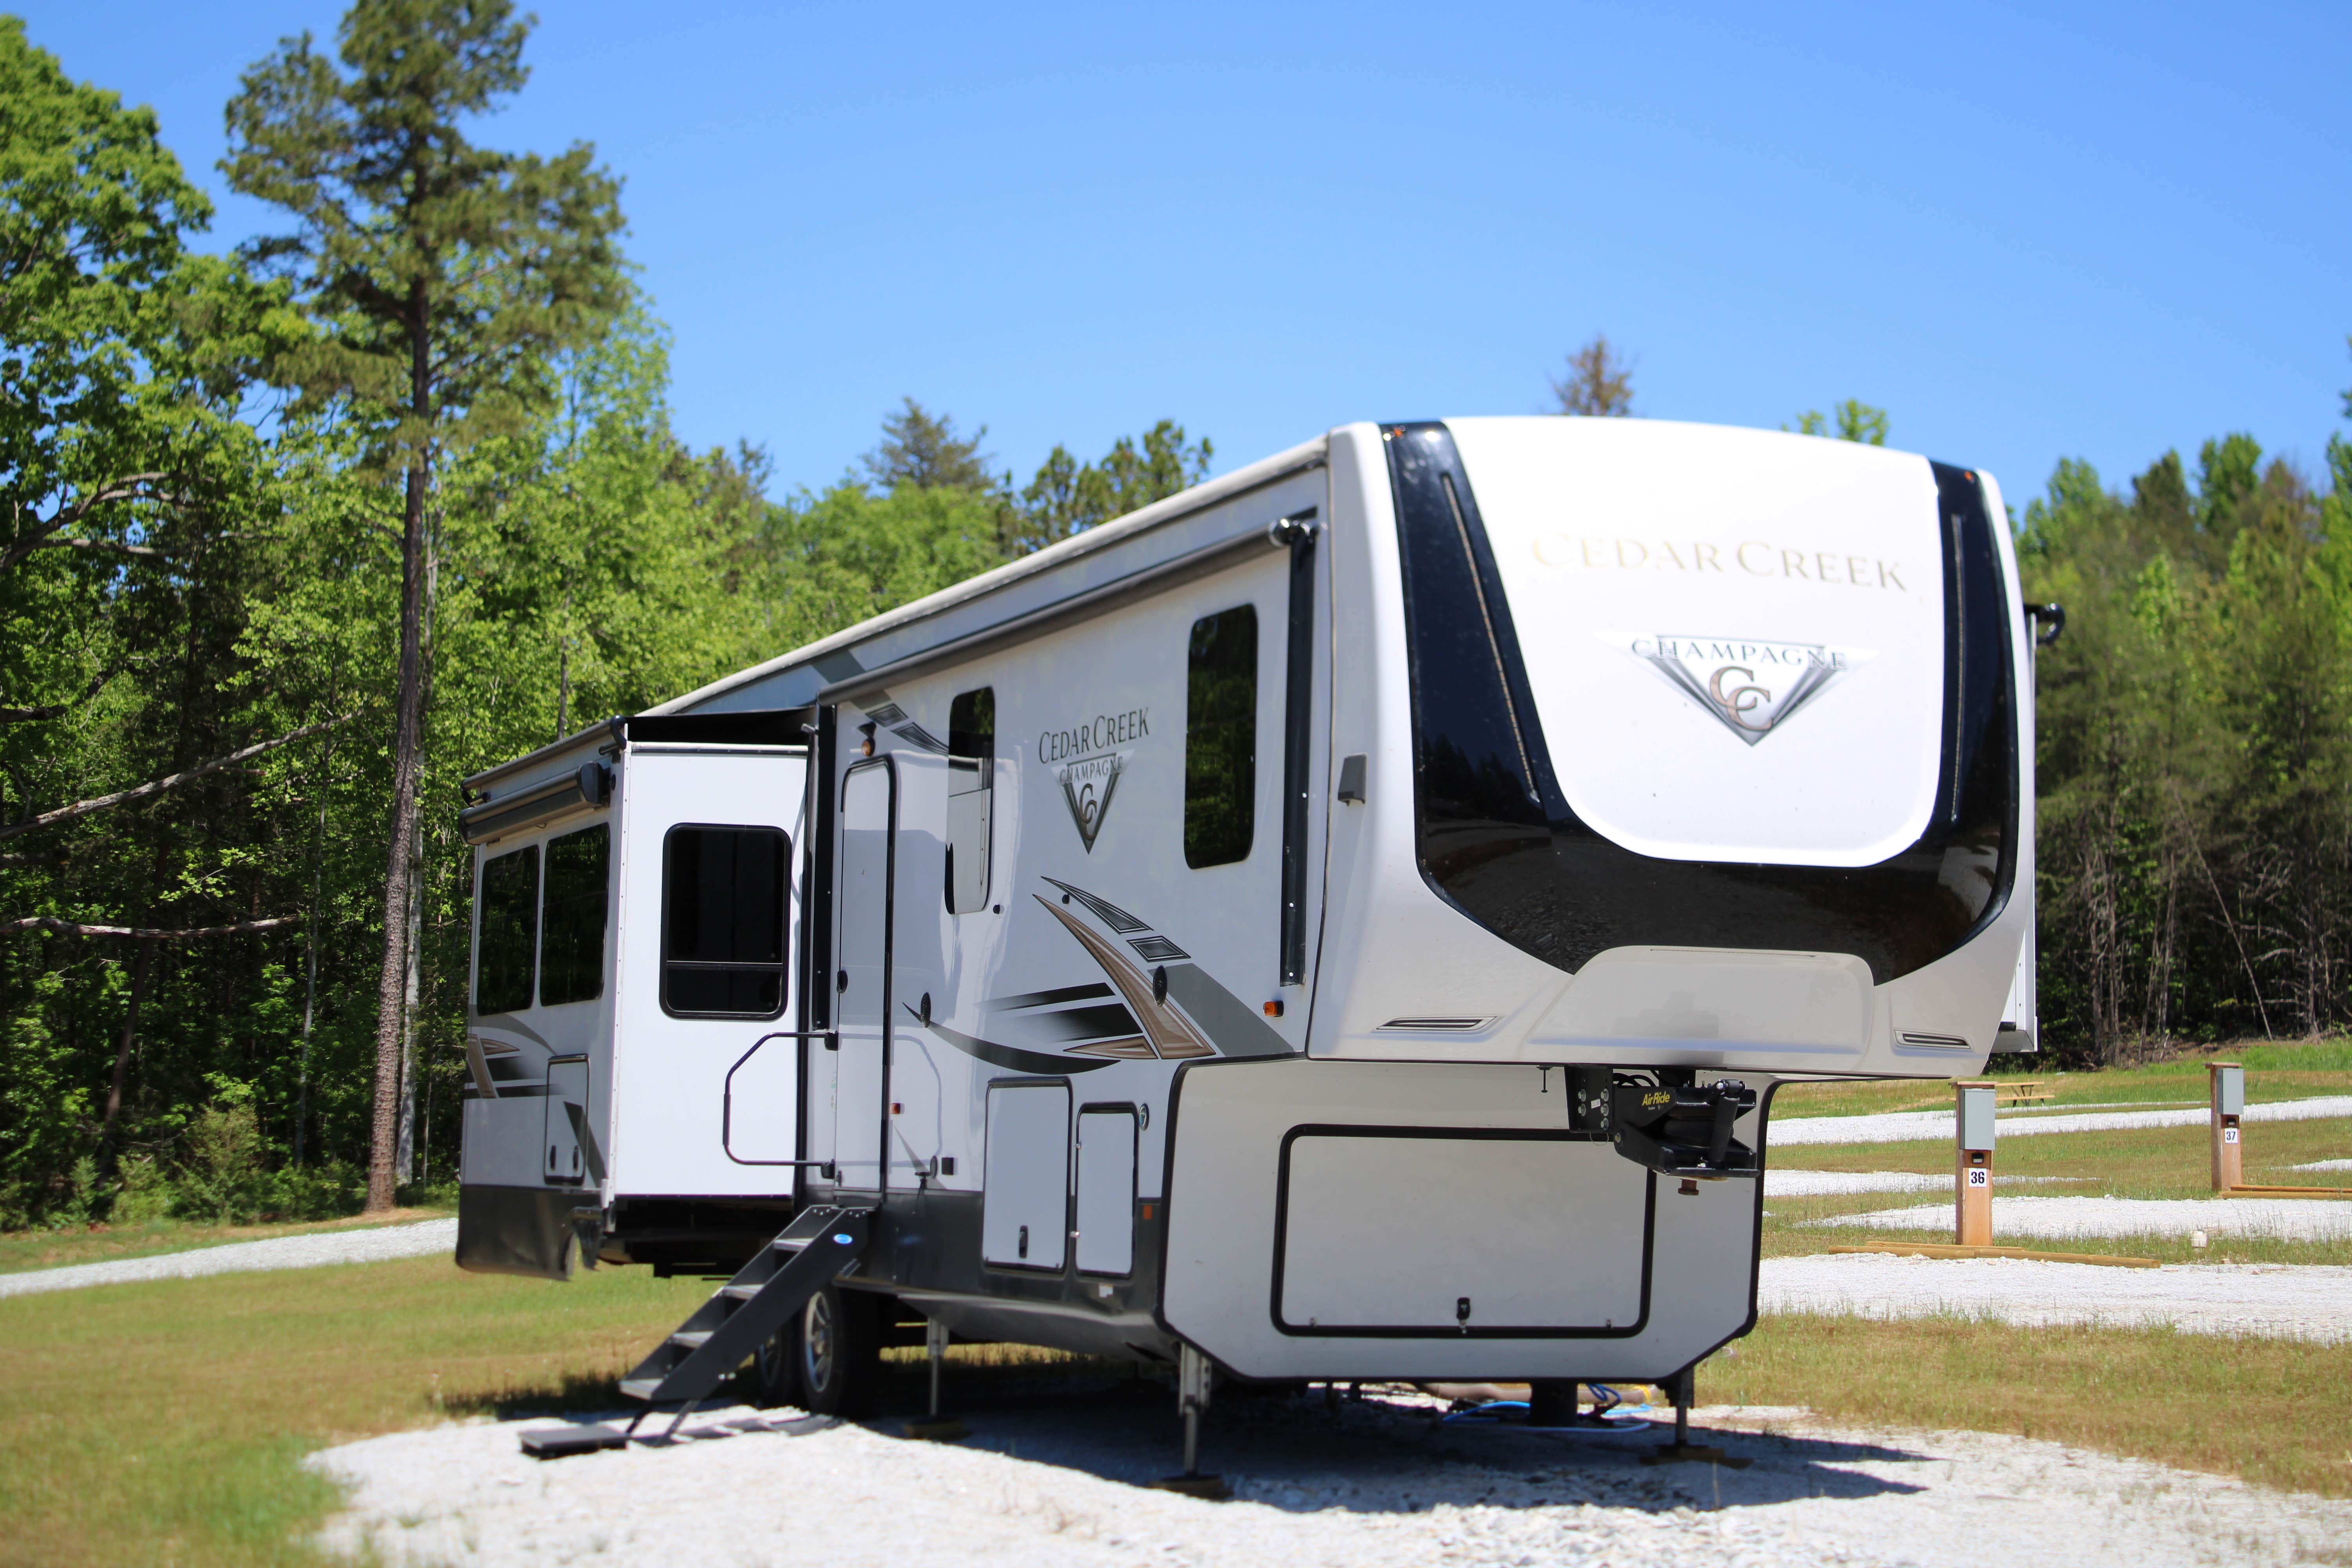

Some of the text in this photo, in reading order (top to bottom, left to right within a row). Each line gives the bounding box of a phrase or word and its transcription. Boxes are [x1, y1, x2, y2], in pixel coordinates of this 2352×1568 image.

[1532, 532, 1907, 592] CEDAR CREEK
[1631, 639, 1847, 671] CHAMPAGNE
[1039, 707, 1149, 764] CEDAR CREEK
[1059, 755, 1123, 786] CHAMPAGNE
[2226, 1131, 2236, 1140] 37
[1971, 1171, 1984, 1183] 36
